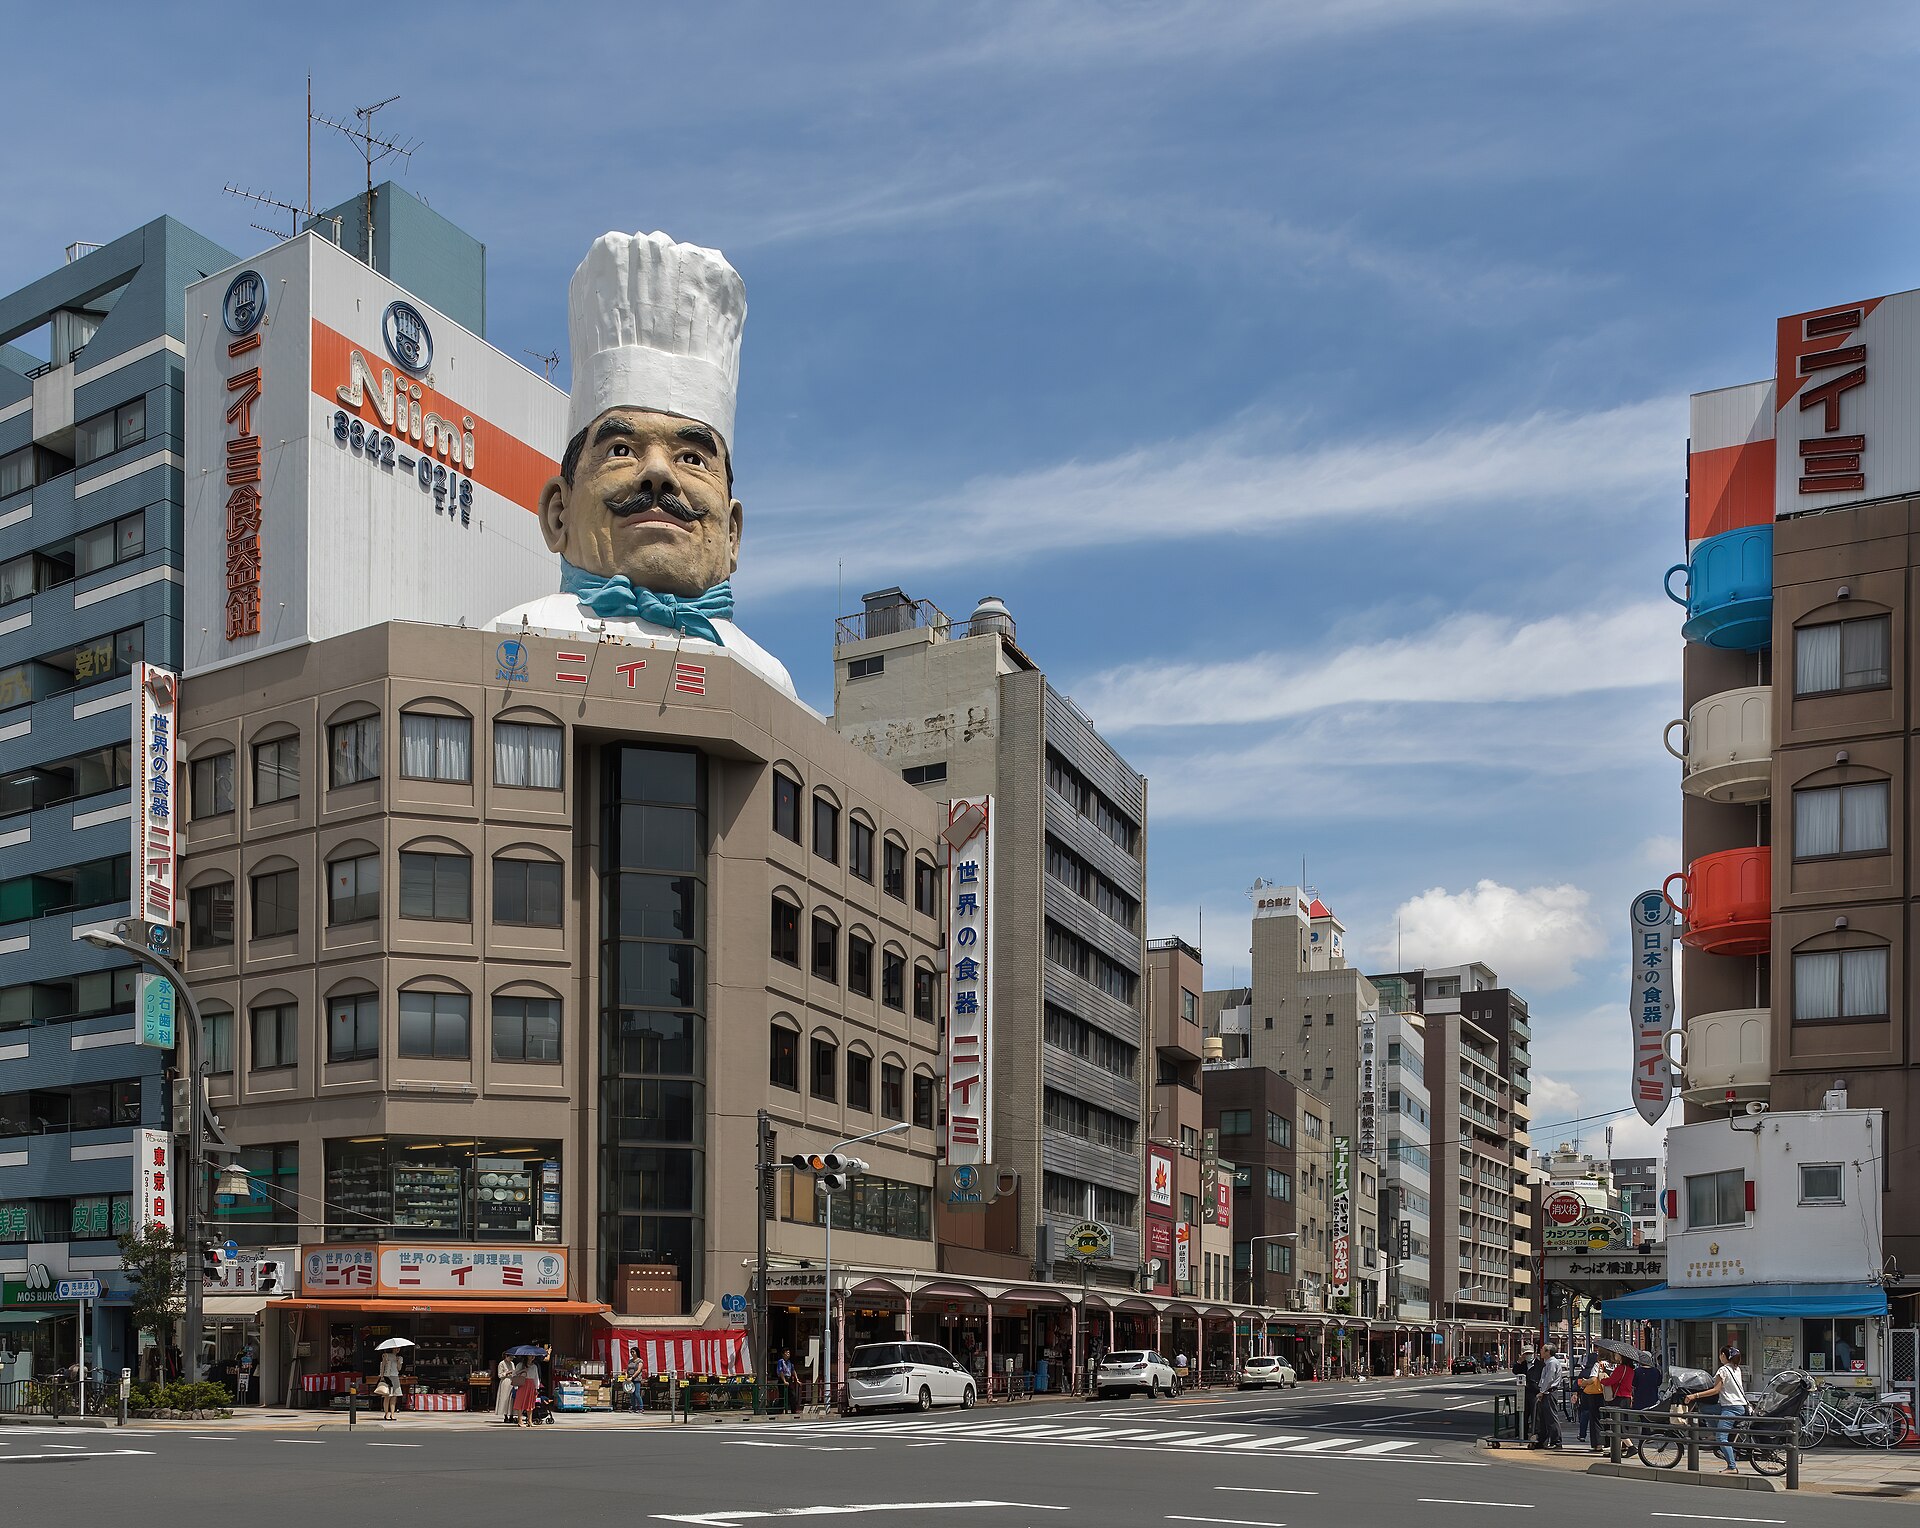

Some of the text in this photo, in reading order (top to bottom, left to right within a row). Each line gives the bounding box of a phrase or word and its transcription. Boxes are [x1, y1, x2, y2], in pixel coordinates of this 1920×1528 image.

[336, 350, 475, 470] Niimi
[1799, 309, 1866, 494] ニイミ
[333, 410, 474, 507] 3842-0213
[225, 332, 262, 641] ニイミ食器館
[75, 643, 113, 680] 受付
[496, 669, 529, 683] Niimi
[556, 651, 706, 696] ニイミ
[149, 713, 171, 911] 世界の食器 ニイミ
[146, 994, 155, 1041] クリニック
[158, 979, 172, 1045] 永石歯科
[952, 860, 980, 1145] 世界の食器 ニイミ
[1640, 932, 1664, 1102] 日本の食器 ニイミ
[949, 1190, 983, 1203] Niimi
[1551, 1203, 1578, 1216] 消火栓
[71, 1200, 132, 1233] 皮膚科
[1545, 1229, 1587, 1239] カジワラ
[325, 1252, 373, 1265] 世界の食器
[325, 1264, 373, 1286] ニイミ
[399, 1251, 524, 1266] 世界の食器・調理器具
[399, 1264, 524, 1287] ニイミ
[1334, 1239, 1348, 1280] かんばん
[1569, 1261, 1662, 1275] かっぱ橋道具街
[16, 1291, 37, 1303] MOS
[536, 1275, 560, 1286] Niimi
